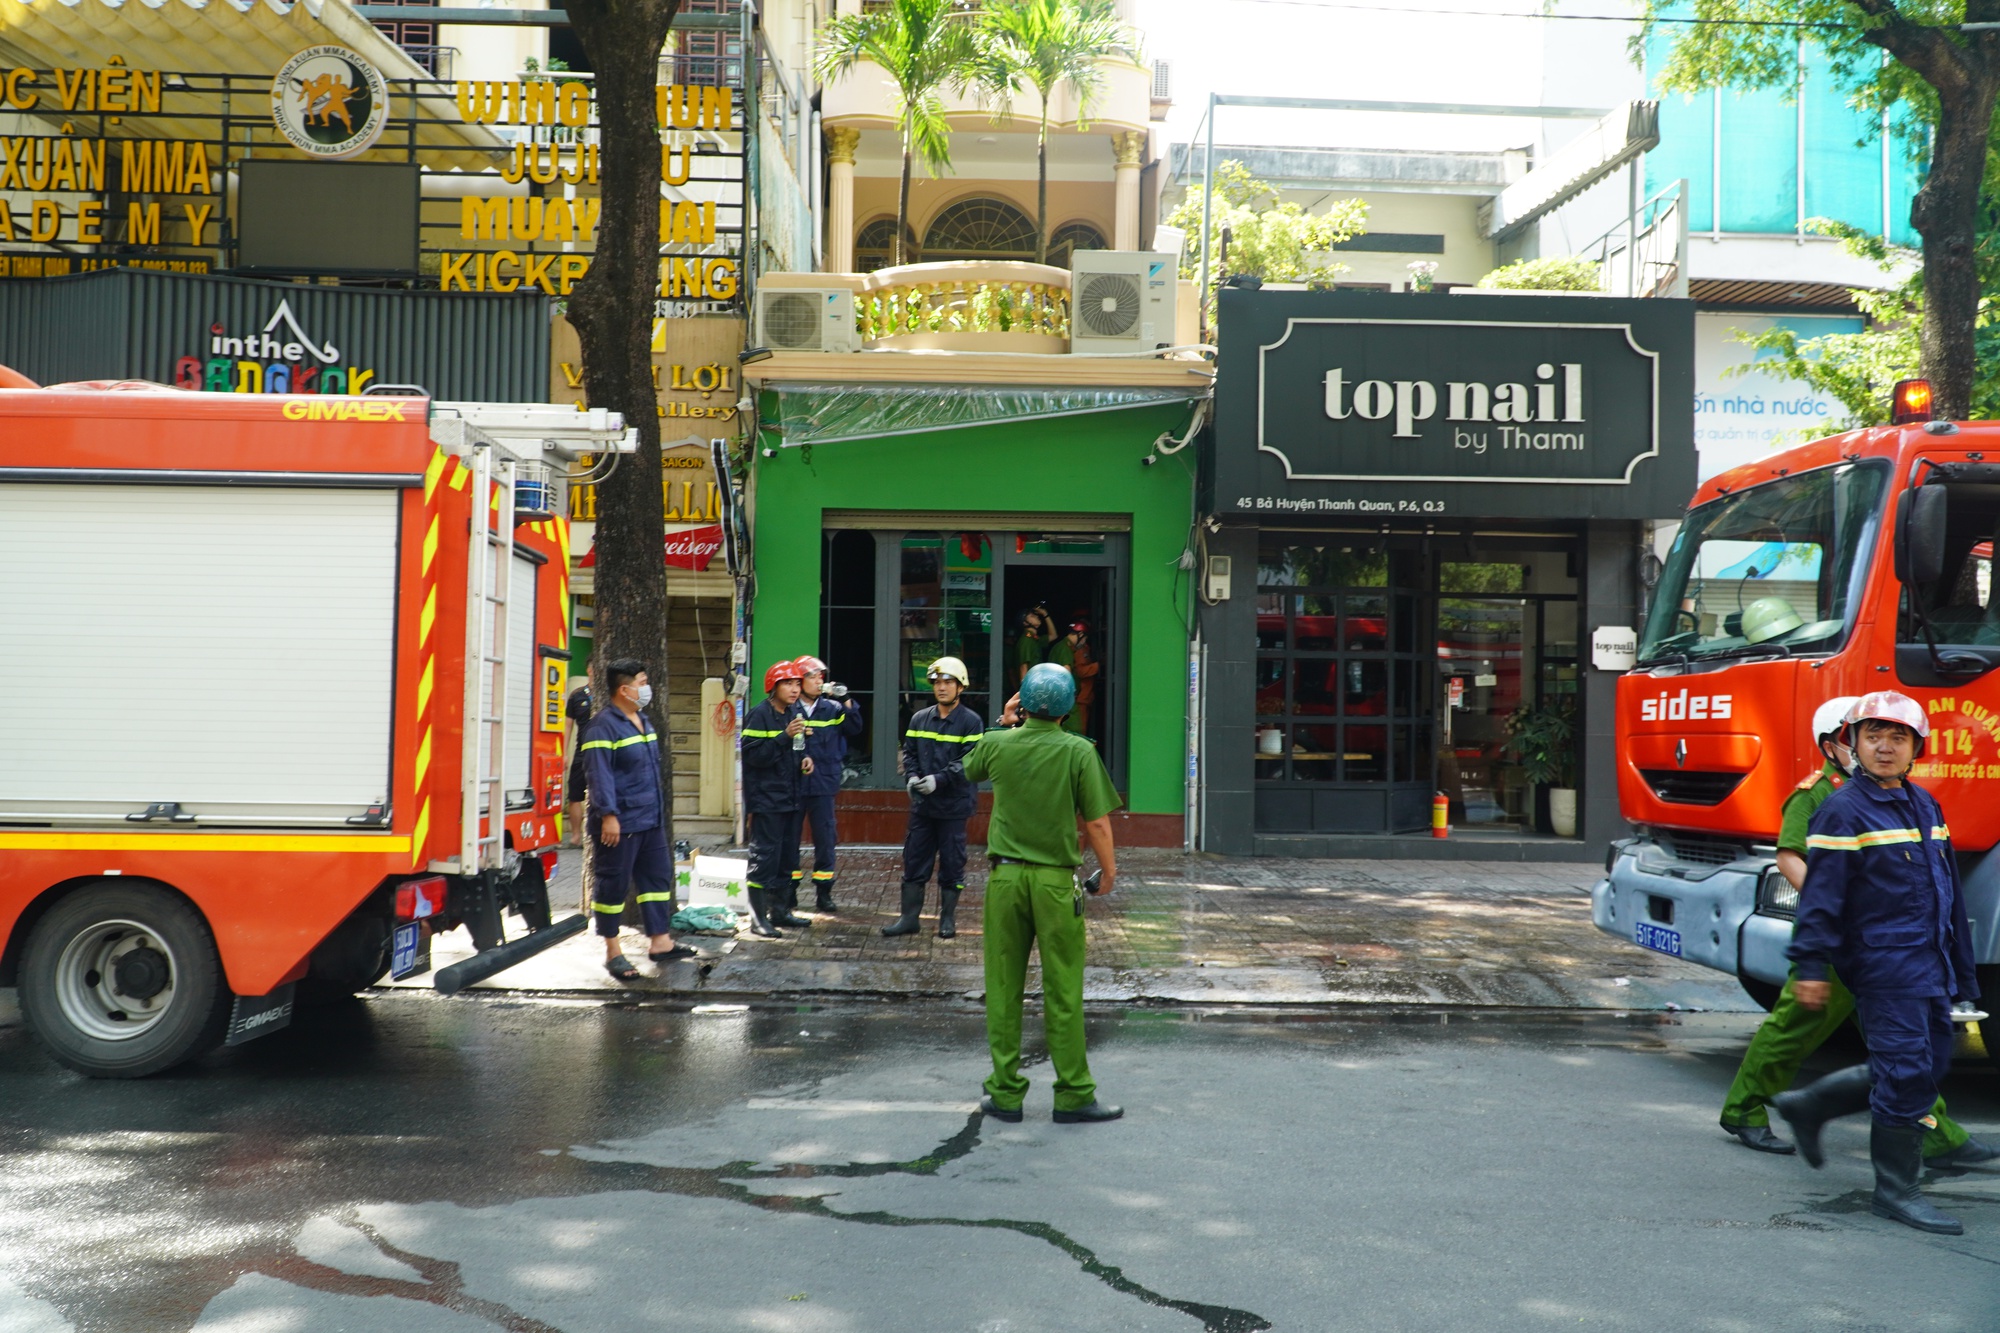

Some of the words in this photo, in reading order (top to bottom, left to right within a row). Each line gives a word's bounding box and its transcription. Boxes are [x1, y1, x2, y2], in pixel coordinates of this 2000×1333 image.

[348, 54, 380, 95] ACADEMY
[54, 55, 162, 125] VIỆN
[457, 81, 589, 127] WING
[274, 105, 288, 131] WING
[287, 130, 312, 151] CHUN
[340, 117, 378, 152] ACADEMY
[0, 122, 105, 191] XUÂN
[121, 140, 211, 194] MMA
[462, 195, 601, 242] MUAY
[282, 400, 406, 421] GIMAEX
[656, 401, 738, 421] allery
[1321, 367, 1438, 438] top
[1445, 363, 1586, 423] nail
[1723, 394, 1765, 414] nhà
[1772, 396, 1828, 416] nước
[1454, 427, 1488, 454] by
[661, 457, 703, 468] SAIGON
[1236, 497, 1252, 508] 45
[1276, 498, 1315, 511] Huyện
[1318, 499, 1355, 510] Thanh
[1423, 501, 1445, 512] Q.3
[1641, 688, 1732, 721] sides
[1928, 696, 1955, 715] AN
[1929, 728, 1973, 755] 114
[1977, 764, 1985, 778] &
